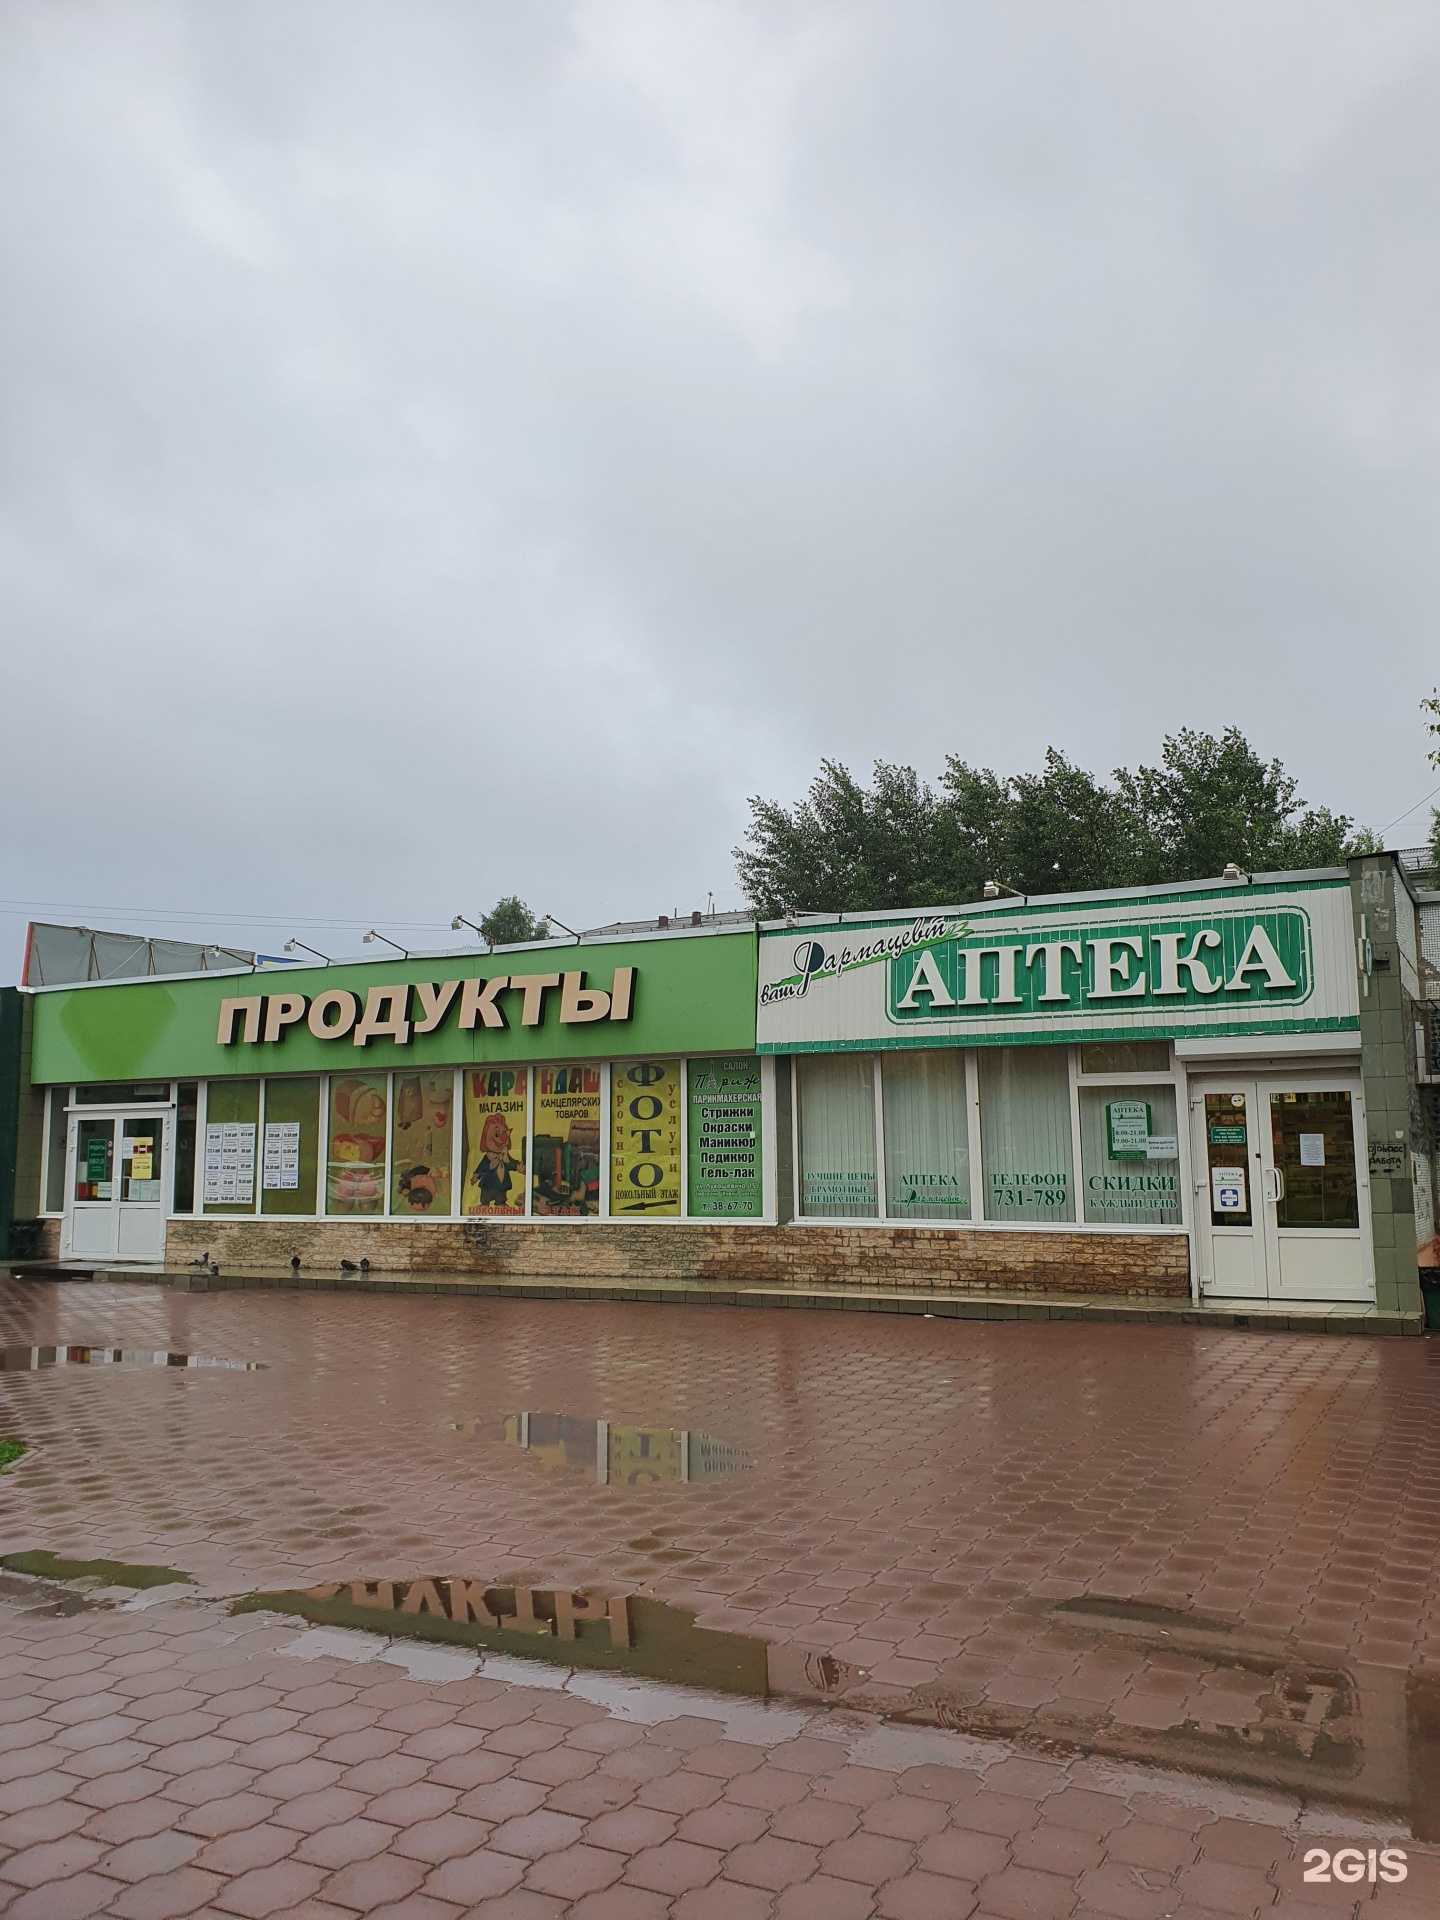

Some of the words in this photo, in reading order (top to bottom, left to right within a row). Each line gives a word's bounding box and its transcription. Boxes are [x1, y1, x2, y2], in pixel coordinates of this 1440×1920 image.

[761, 980, 796, 1005] ваш
[794, 916, 949, 996] Фармацевт
[896, 924, 1301, 1009] АПТЕКА
[216, 967, 636, 1047] ПРОДУКТЫ
[480, 1101, 524, 1113] МАГАЗИН
[701, 1107, 753, 1119] Стрижки
[555, 1110, 589, 1119] ТОВАРОВ
[627, 1062, 665, 1188] ФОТО
[703, 1123, 753, 1133] Окраски
[700, 1137, 756, 1149] Маникюр
[701, 1152, 755, 1164] Педикюр
[701, 1167, 755, 1178] Гель-лак
[900, 1174, 959, 1186] АПТЕКА
[989, 1173, 1067, 1187] ТЕЛЕФОН
[1088, 1175, 1175, 1193] СКИДКИ
[615, 1188, 657, 1199] ЦОКОЛЬНЫЙ
[660, 1189, 679, 1199] ЭТАЖ
[993, 1189, 1067, 1207] 731-789
[1145, 1198, 1177, 1209] ДЕНЬ
